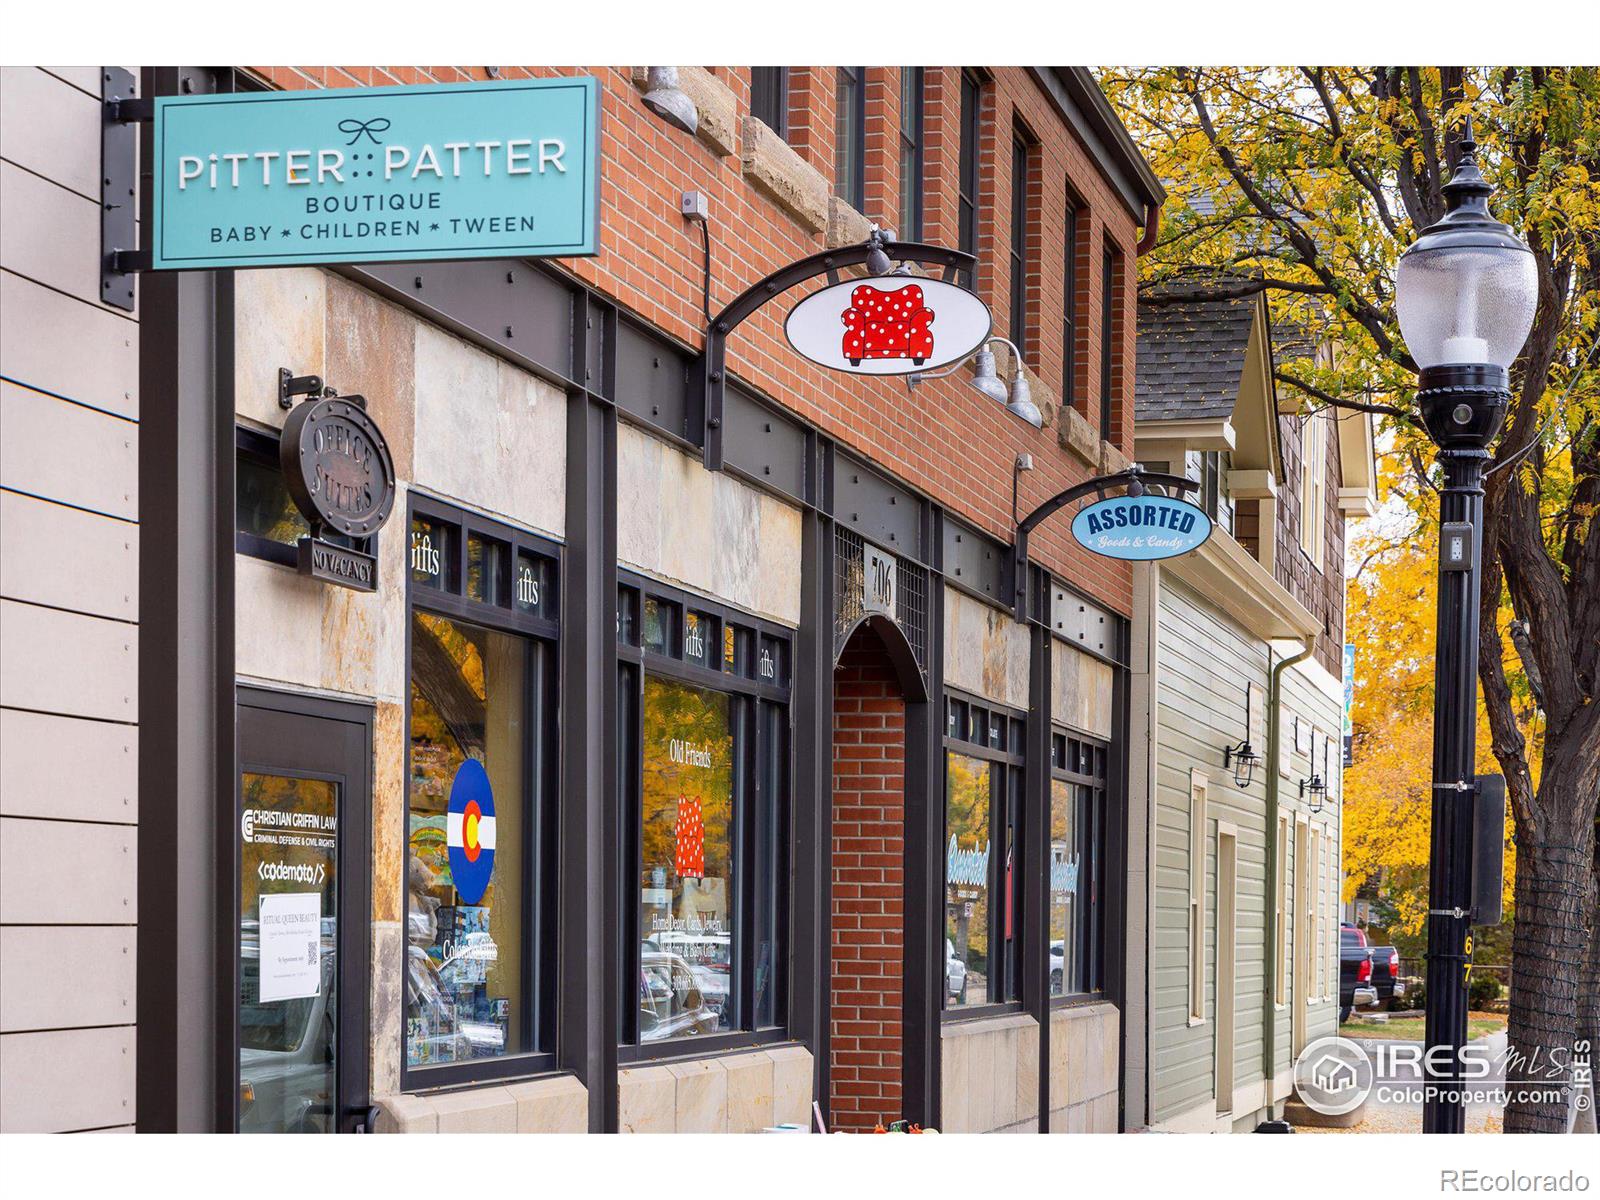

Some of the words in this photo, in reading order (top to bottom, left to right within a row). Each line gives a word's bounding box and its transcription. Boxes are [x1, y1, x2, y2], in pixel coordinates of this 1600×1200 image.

[383, 138, 568, 180] PATTER
[305, 191, 442, 214] BOUTIQUE
[210, 225, 272, 243] BABY
[299, 219, 420, 239] CHILDREN
[449, 215, 536, 234] TWEEN
[313, 423, 372, 475] OFFICE
[313, 463, 373, 514] SUITES
[1087, 504, 1196, 535] ASSORTED
[1097, 535, 1131, 549] Goods
[1132, 536, 1145, 548] &
[1145, 535, 1183, 551] Candy
[314, 549, 327, 570] NO
[328, 552, 372, 582] VACANCY
[871, 555, 892, 607] 706
[516, 566, 539, 605] ifts
[685, 625, 703, 659] ifts
[759, 648, 774, 679] ifts
[669, 738, 684, 764] Old
[685, 741, 711, 769] Friends
[253, 809, 292, 827] CHRISTIAN
[292, 812, 320, 828] GRIFFIN
[320, 815, 337, 830] LAW
[254, 834, 278, 845] CRIMINAL
[278, 835, 301, 846] DEFENSE
[305, 837, 318, 847] CIVIL
[318, 838, 335, 848] RIGHTS
